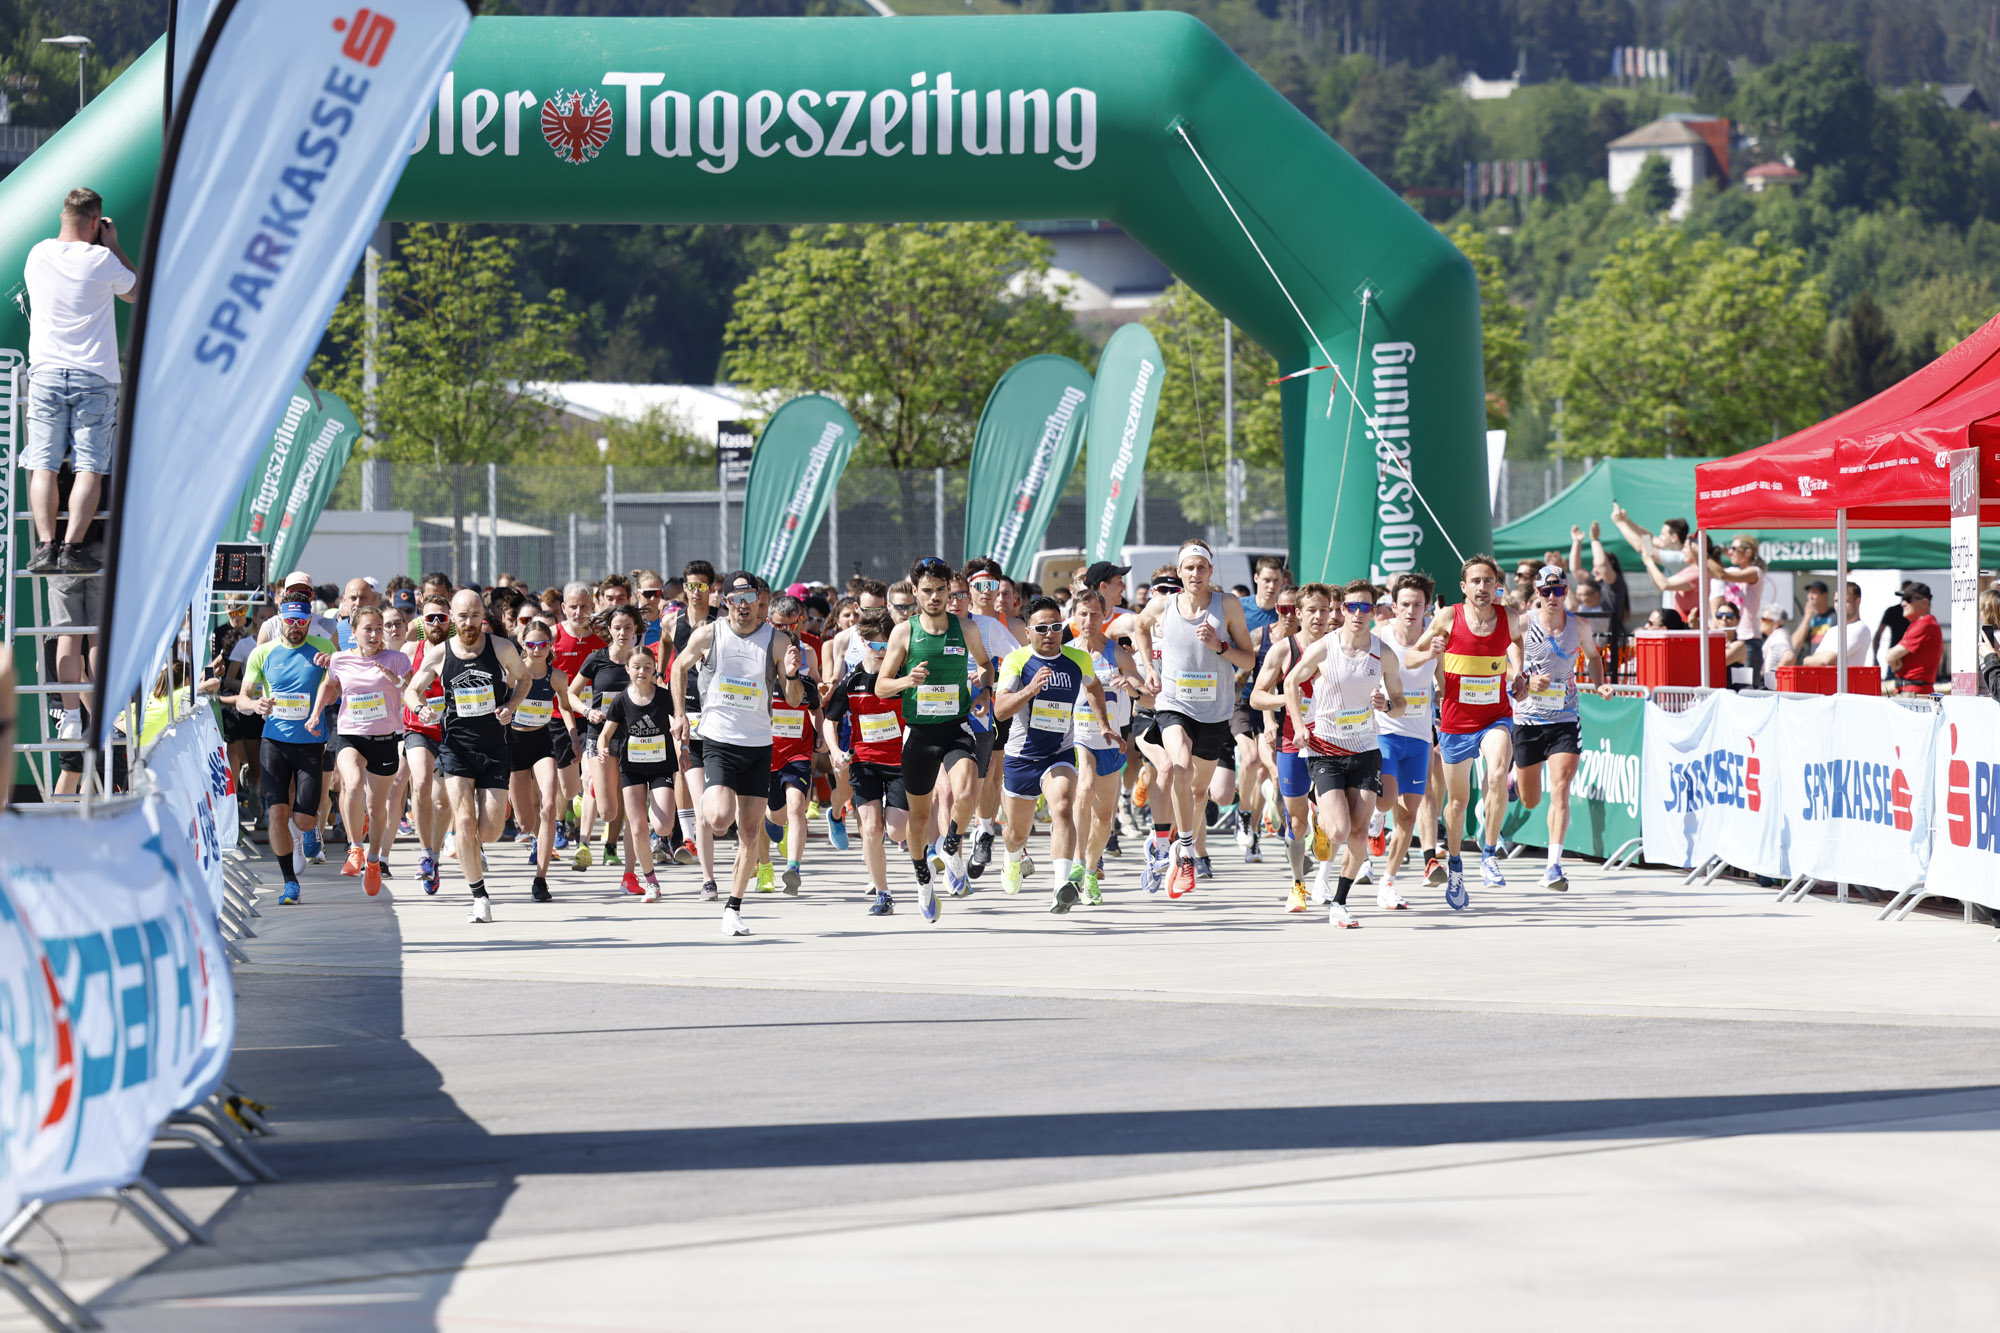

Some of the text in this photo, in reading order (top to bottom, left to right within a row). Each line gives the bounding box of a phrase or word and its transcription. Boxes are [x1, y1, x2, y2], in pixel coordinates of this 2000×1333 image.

[601, 71, 1098, 174] Tageszeitung
[194, 65, 371, 375] SPARKASSE
[250, 394, 311, 516] Tageszeitung
[1015, 386, 1086, 499] Tageszeitung
[1111, 358, 1154, 489] Tageszeitung
[628, 727, 660, 737] adidas
[726, 678, 752, 687] SPARKASSE
